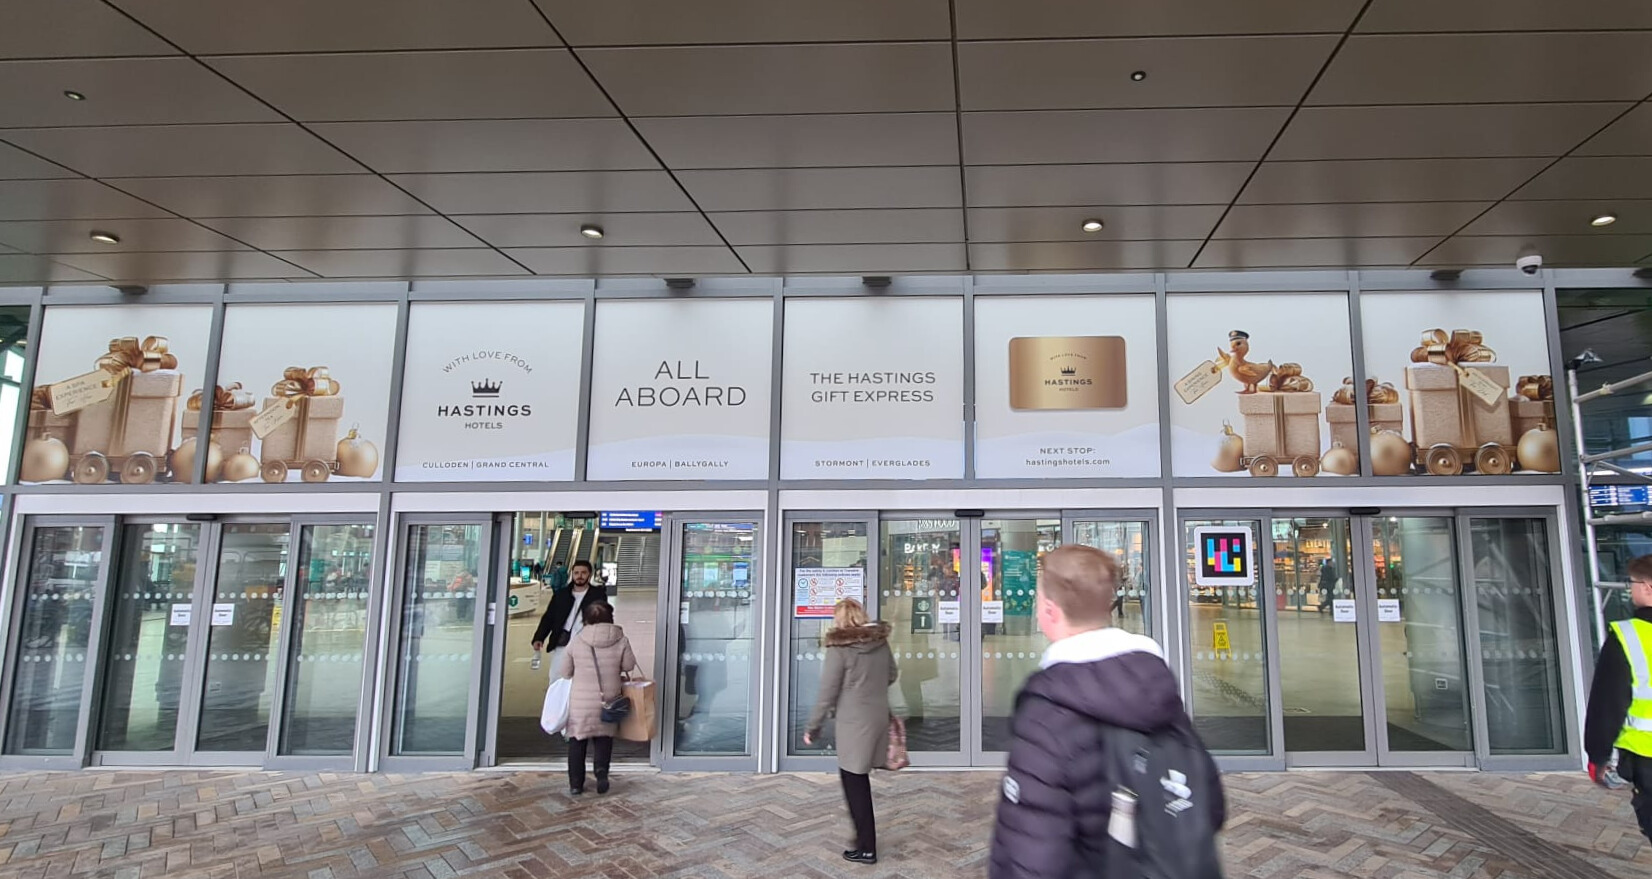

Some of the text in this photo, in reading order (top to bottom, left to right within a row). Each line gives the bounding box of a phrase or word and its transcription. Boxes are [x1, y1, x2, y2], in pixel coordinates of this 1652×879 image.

[442, 350, 533, 373] WITH LOVE FROM
[654, 360, 710, 380] ALL
[809, 371, 936, 385] THE HASTINGS
[1044, 378, 1093, 386] HASTINGS
[614, 387, 747, 407] ABOARD
[811, 390, 934, 403] GIFT EXPRESS
[437, 404, 532, 417] HASTINGS
[464, 421, 503, 430] HOTELS
[1040, 447, 1096, 455] NEXT STOP:
[422, 461, 549, 469] CULLODEN GRAND CENTRAL
[631, 460, 729, 468] EUROPA BALLYGALLY
[815, 459, 931, 467] STORMONT EVERGLADES
[1026, 458, 1110, 467] hastingshotels.com
